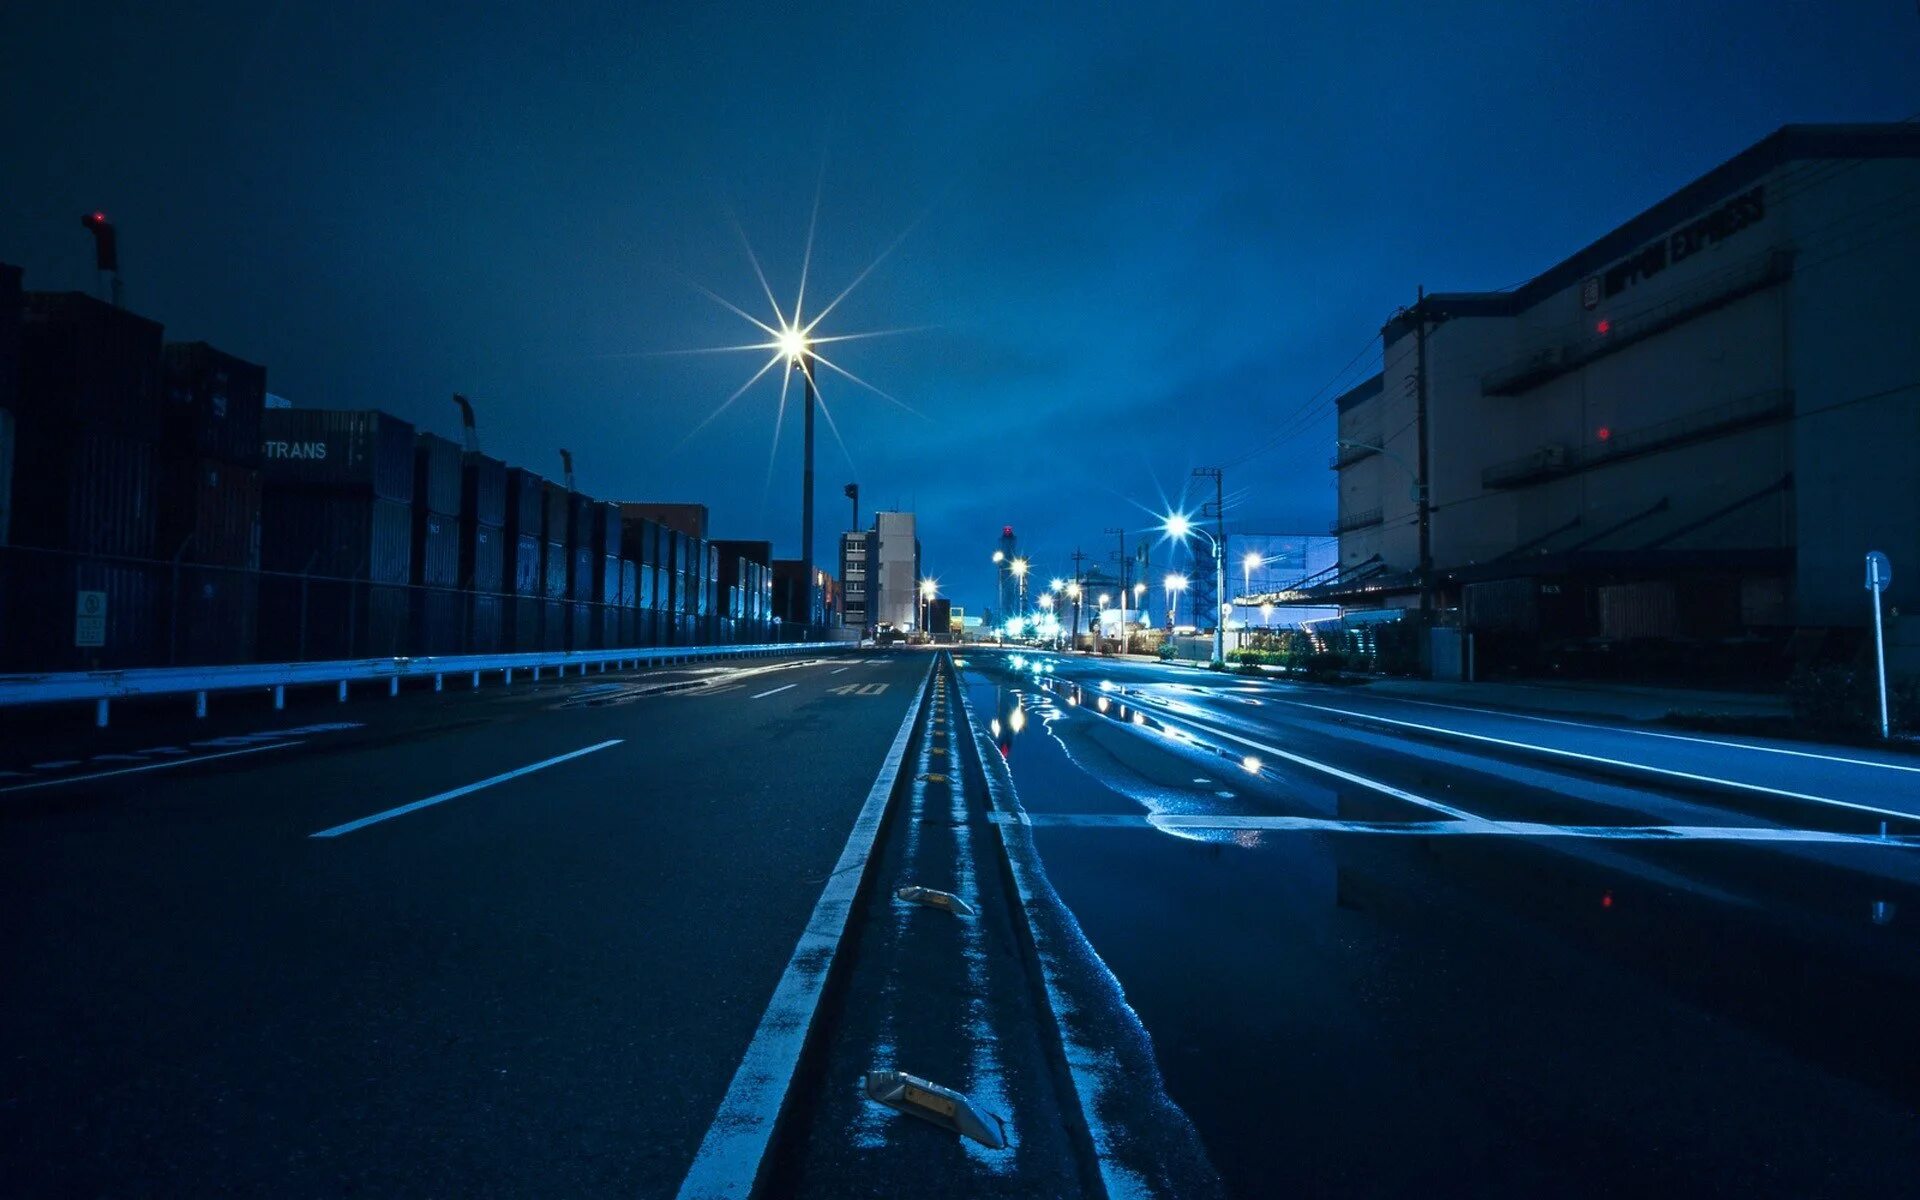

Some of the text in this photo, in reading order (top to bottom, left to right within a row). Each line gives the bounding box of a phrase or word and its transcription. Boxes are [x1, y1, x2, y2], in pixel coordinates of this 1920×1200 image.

[1670, 185, 1764, 264] EXPRESS
[264, 440, 328, 460] TRANS
[825, 683, 890, 695] 40
